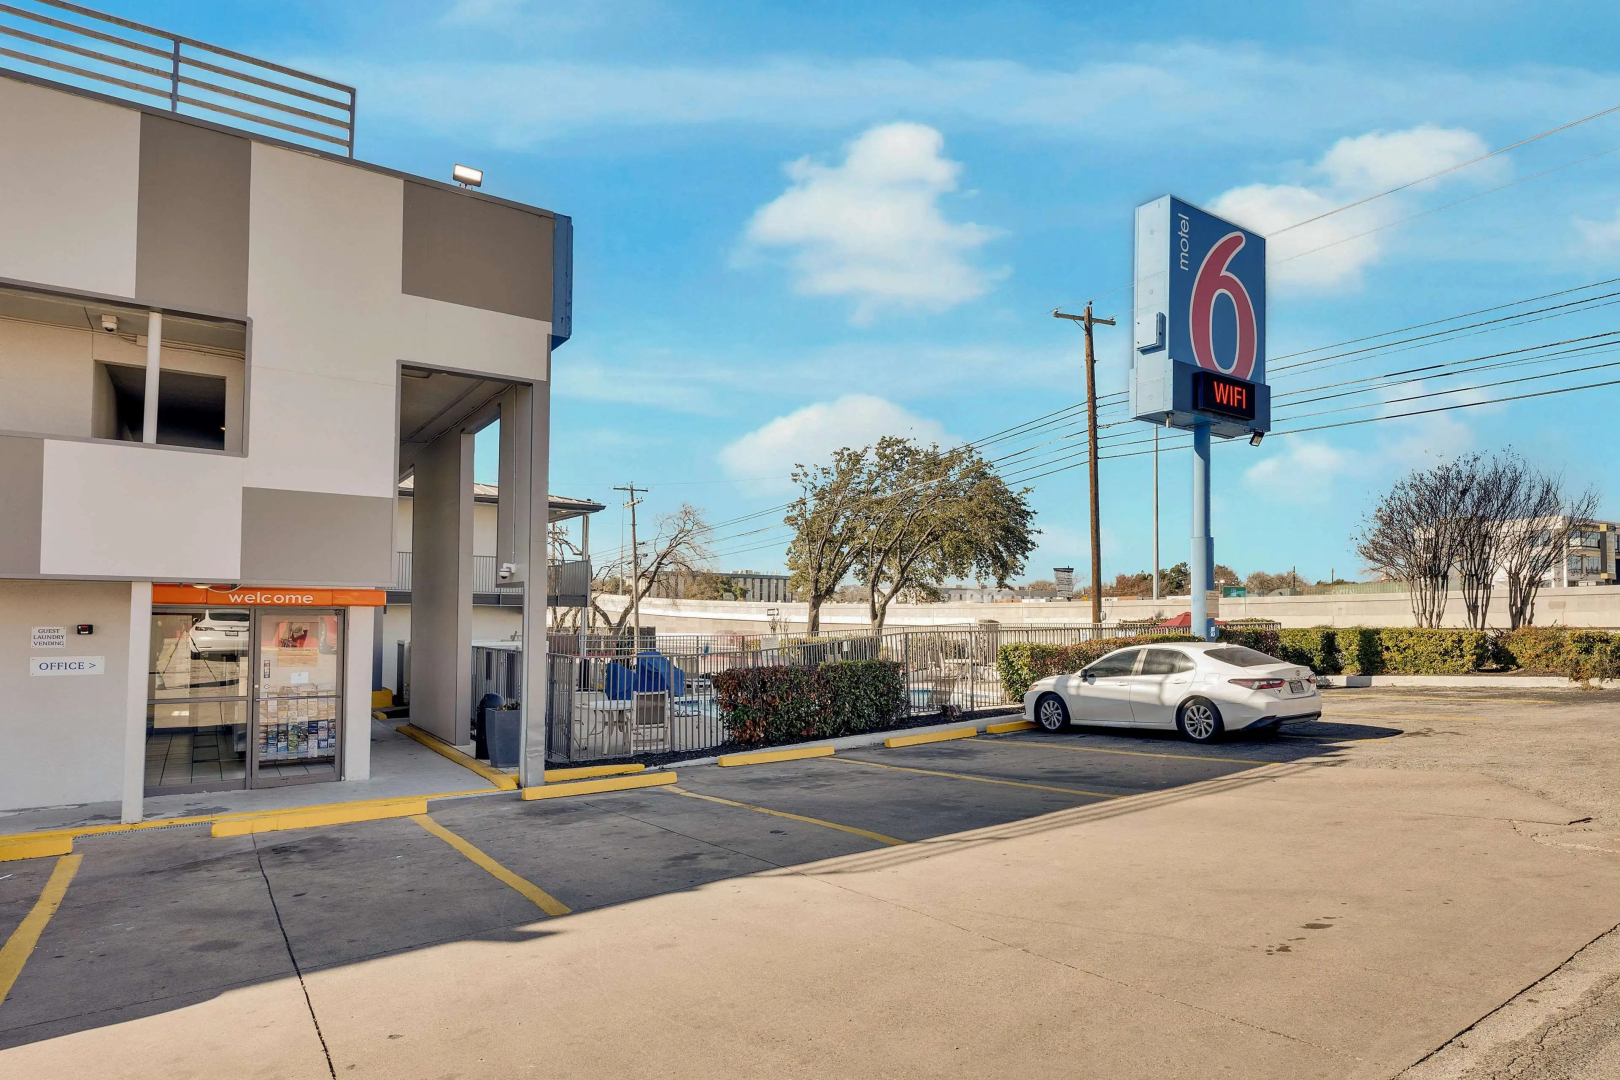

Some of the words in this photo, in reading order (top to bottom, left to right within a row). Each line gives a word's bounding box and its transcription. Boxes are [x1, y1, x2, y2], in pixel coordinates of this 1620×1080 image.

[1178, 213, 1190, 271] motel
[1189, 230, 1258, 381] 6
[1213, 381, 1247, 409] WIFI
[229, 591, 314, 604] welcome
[38, 661, 85, 671] OFFICE
